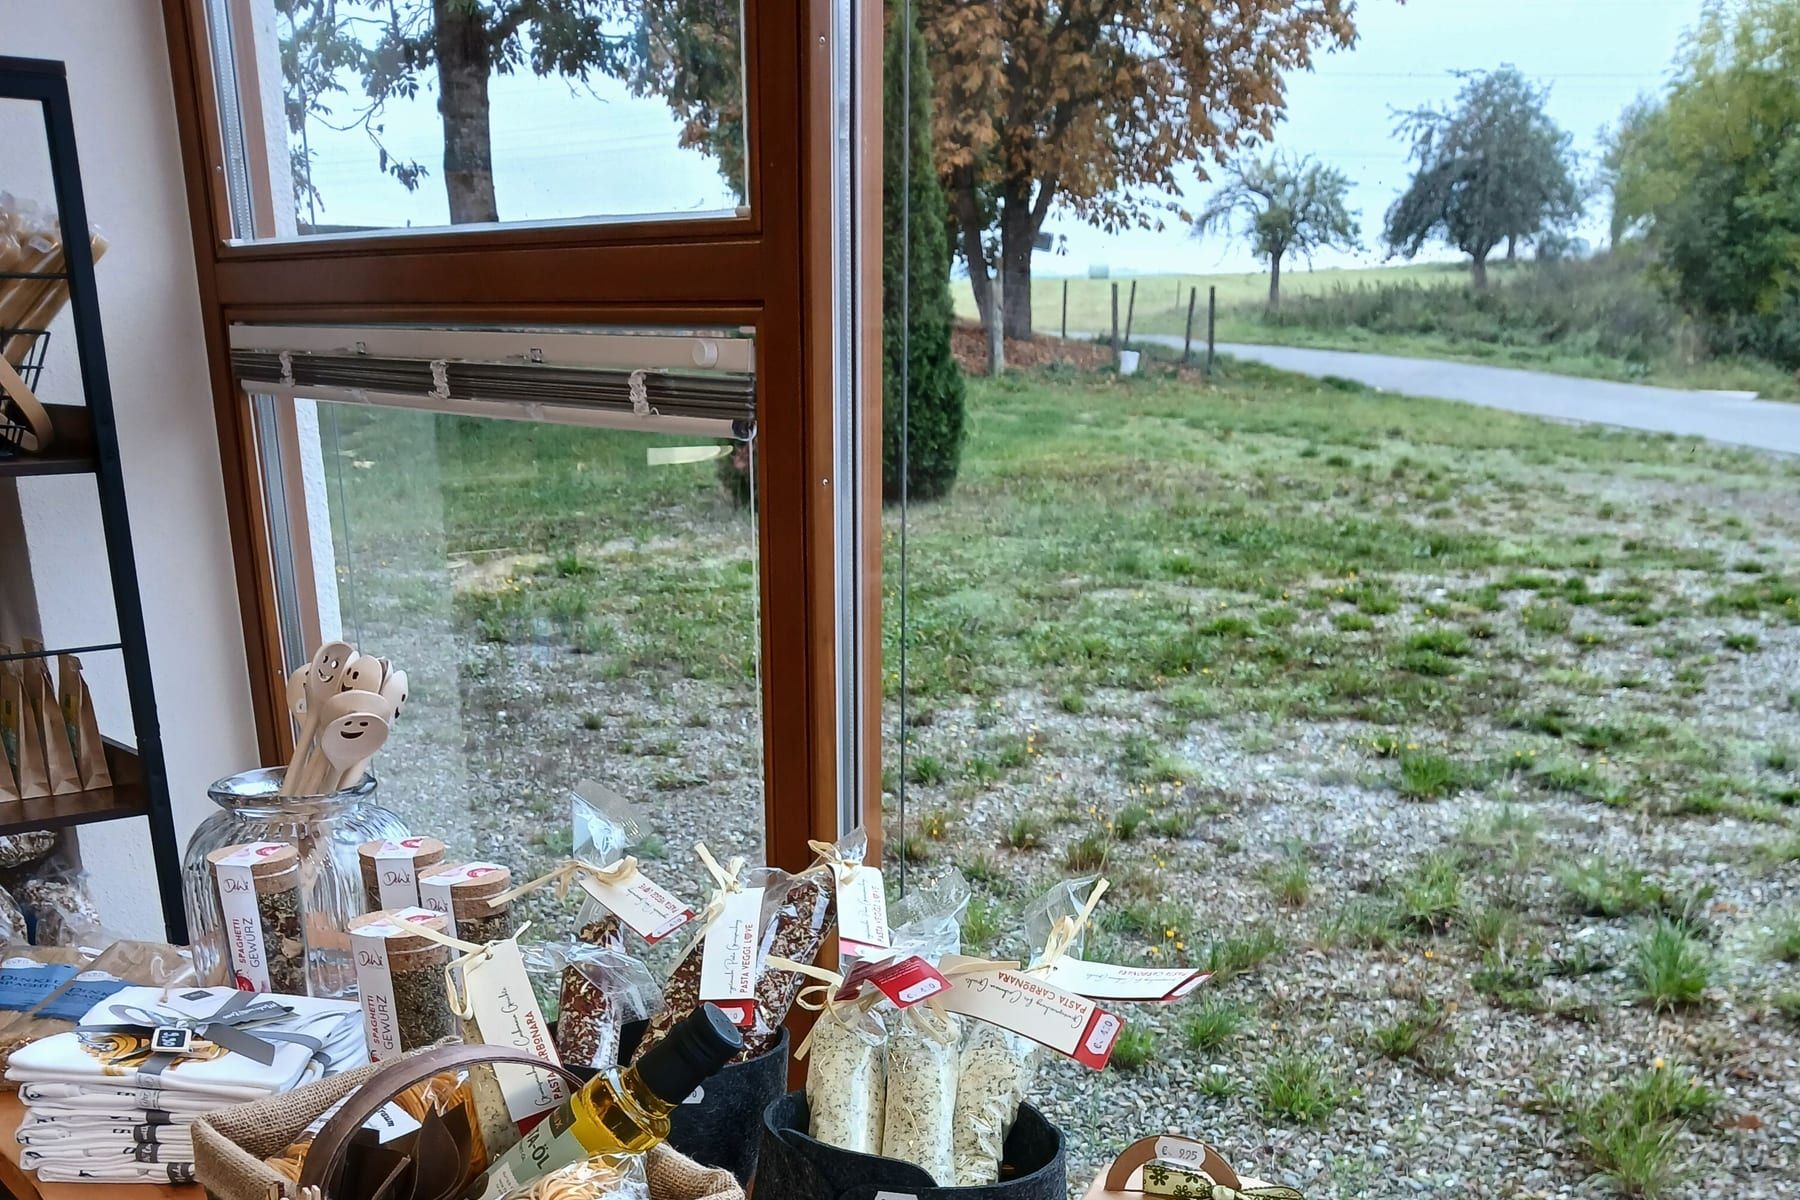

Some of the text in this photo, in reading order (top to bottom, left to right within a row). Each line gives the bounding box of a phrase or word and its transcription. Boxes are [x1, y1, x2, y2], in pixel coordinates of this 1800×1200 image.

[232, 918, 247, 964] SPAGHETTI
[243, 917, 260, 968] GEWÜRZ
[742, 946, 752, 970] VEGGI
[739, 972, 749, 993] PASTA
[998, 971, 1087, 1014] PASTA CARBONARA
[367, 995, 381, 1044] SPAGHETTI
[376, 995, 394, 1050] GEWÜRZ
[524, 1010, 551, 1062] ARBONARA
[527, 1127, 550, 1170] A-ÖL
